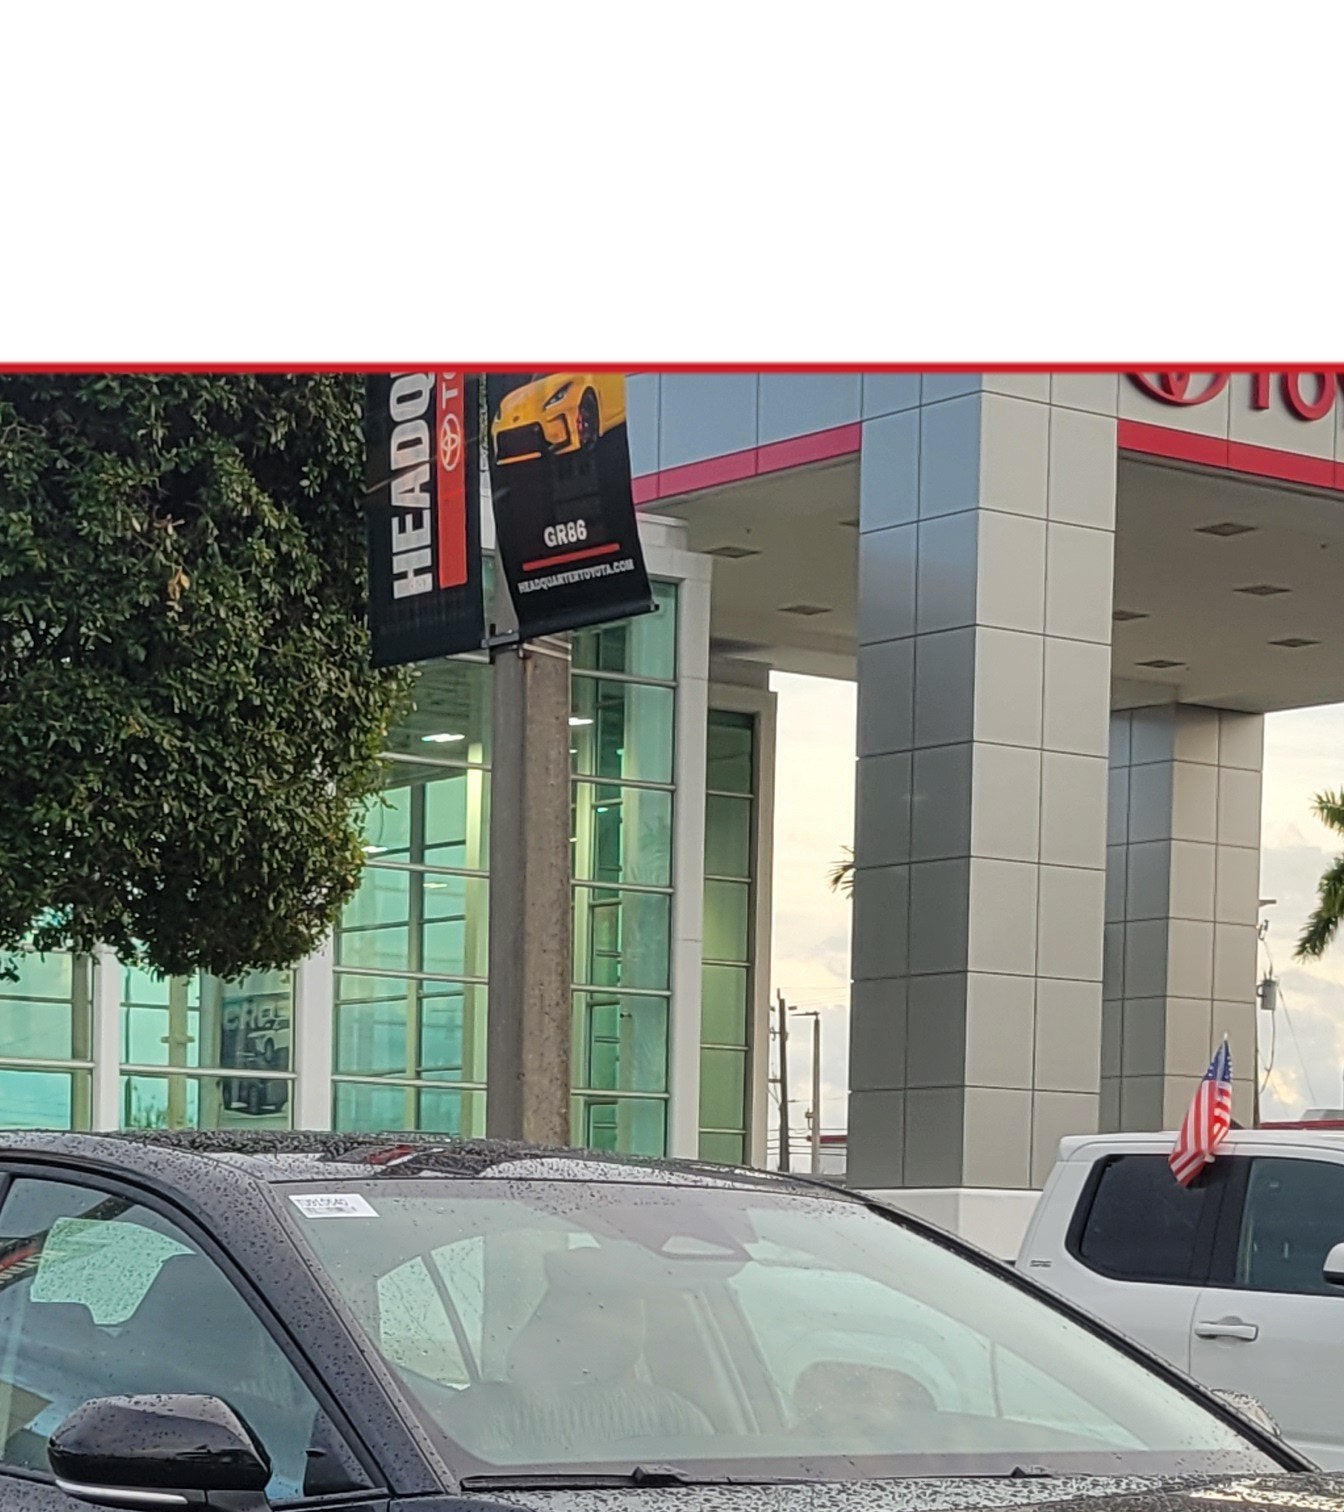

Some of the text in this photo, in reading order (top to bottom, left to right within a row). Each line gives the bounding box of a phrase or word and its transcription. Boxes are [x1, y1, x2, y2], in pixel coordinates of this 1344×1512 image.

[390, 373, 435, 599] HEADQ
[543, 518, 588, 548] GR86
[518, 559, 634, 593] HEADQUARTERTOYOTA.COM
